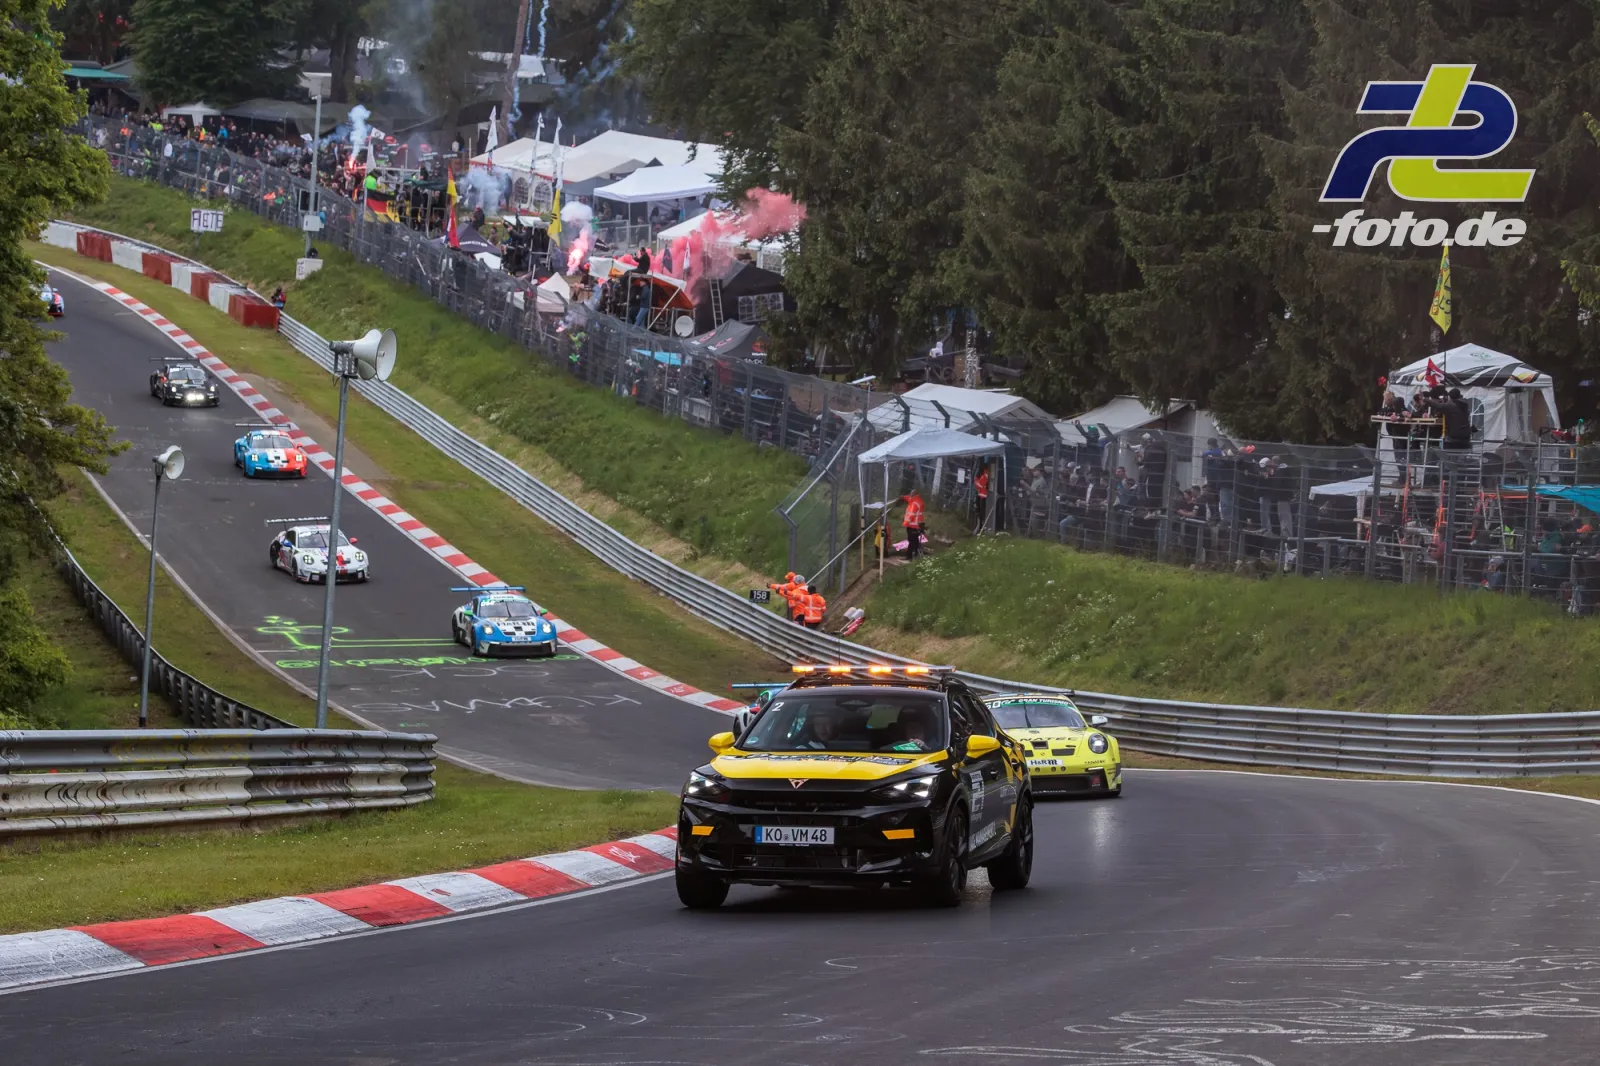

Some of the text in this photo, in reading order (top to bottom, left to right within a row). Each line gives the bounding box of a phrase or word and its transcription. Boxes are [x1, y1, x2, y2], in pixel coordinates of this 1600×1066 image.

[753, 590, 767, 600] 158
[772, 701, 785, 712] 2
[1040, 698, 1069, 706] TURISMO
[765, 828, 827, 842] KO VM 48
